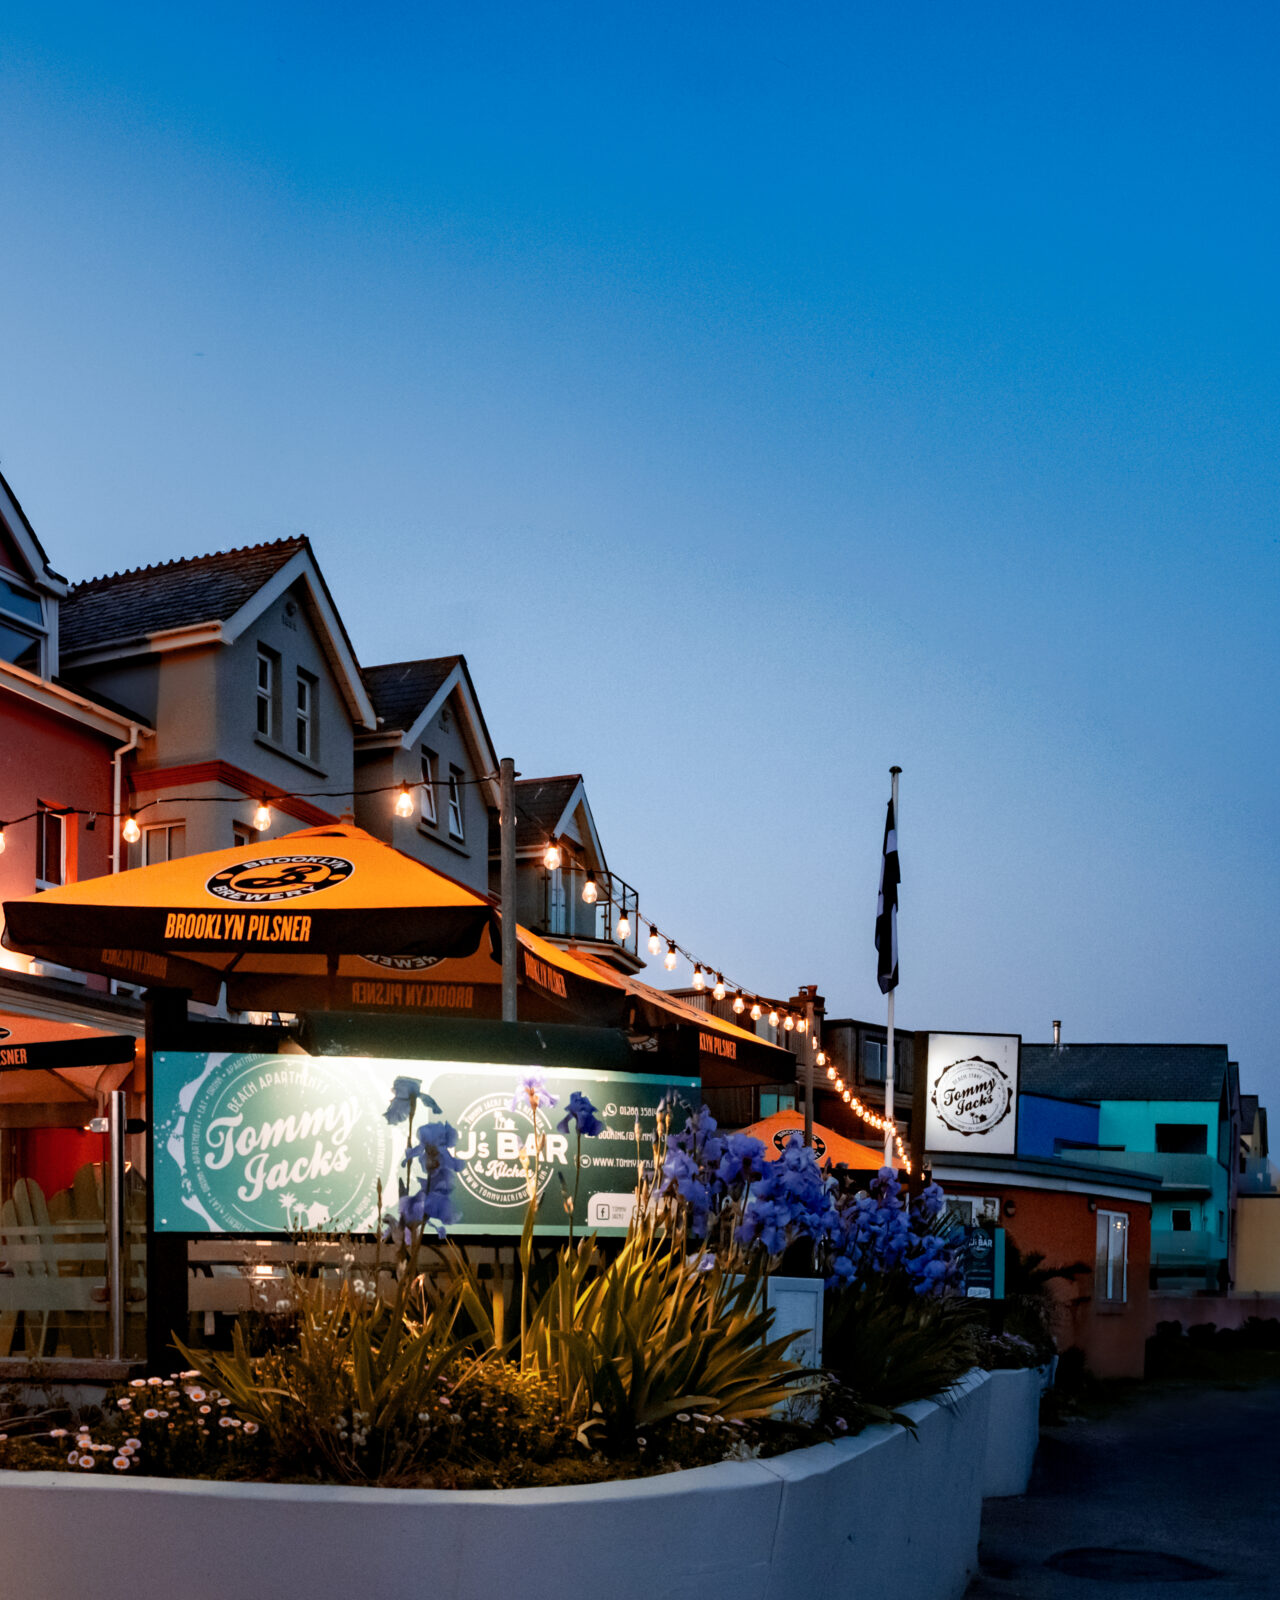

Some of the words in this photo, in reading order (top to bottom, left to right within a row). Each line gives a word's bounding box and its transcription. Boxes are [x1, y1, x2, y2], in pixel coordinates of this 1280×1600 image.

[243, 856, 349, 870] BROOKLYN
[212, 884, 315, 901] BREWERY
[164, 913, 246, 940] BROOKLYN
[246, 915, 312, 942] PILSNER
[714, 1036, 737, 1060] PILSNER
[227, 1081, 258, 1113] BEACH
[944, 1078, 996, 1106] Tommy
[955, 1094, 993, 1116] Jacks
[205, 1096, 362, 1170] Tommy
[448, 1131, 490, 1160] J's
[497, 1132, 568, 1164] BAR
[238, 1140, 351, 1202] Jacks
[474, 1160, 485, 1174] &
